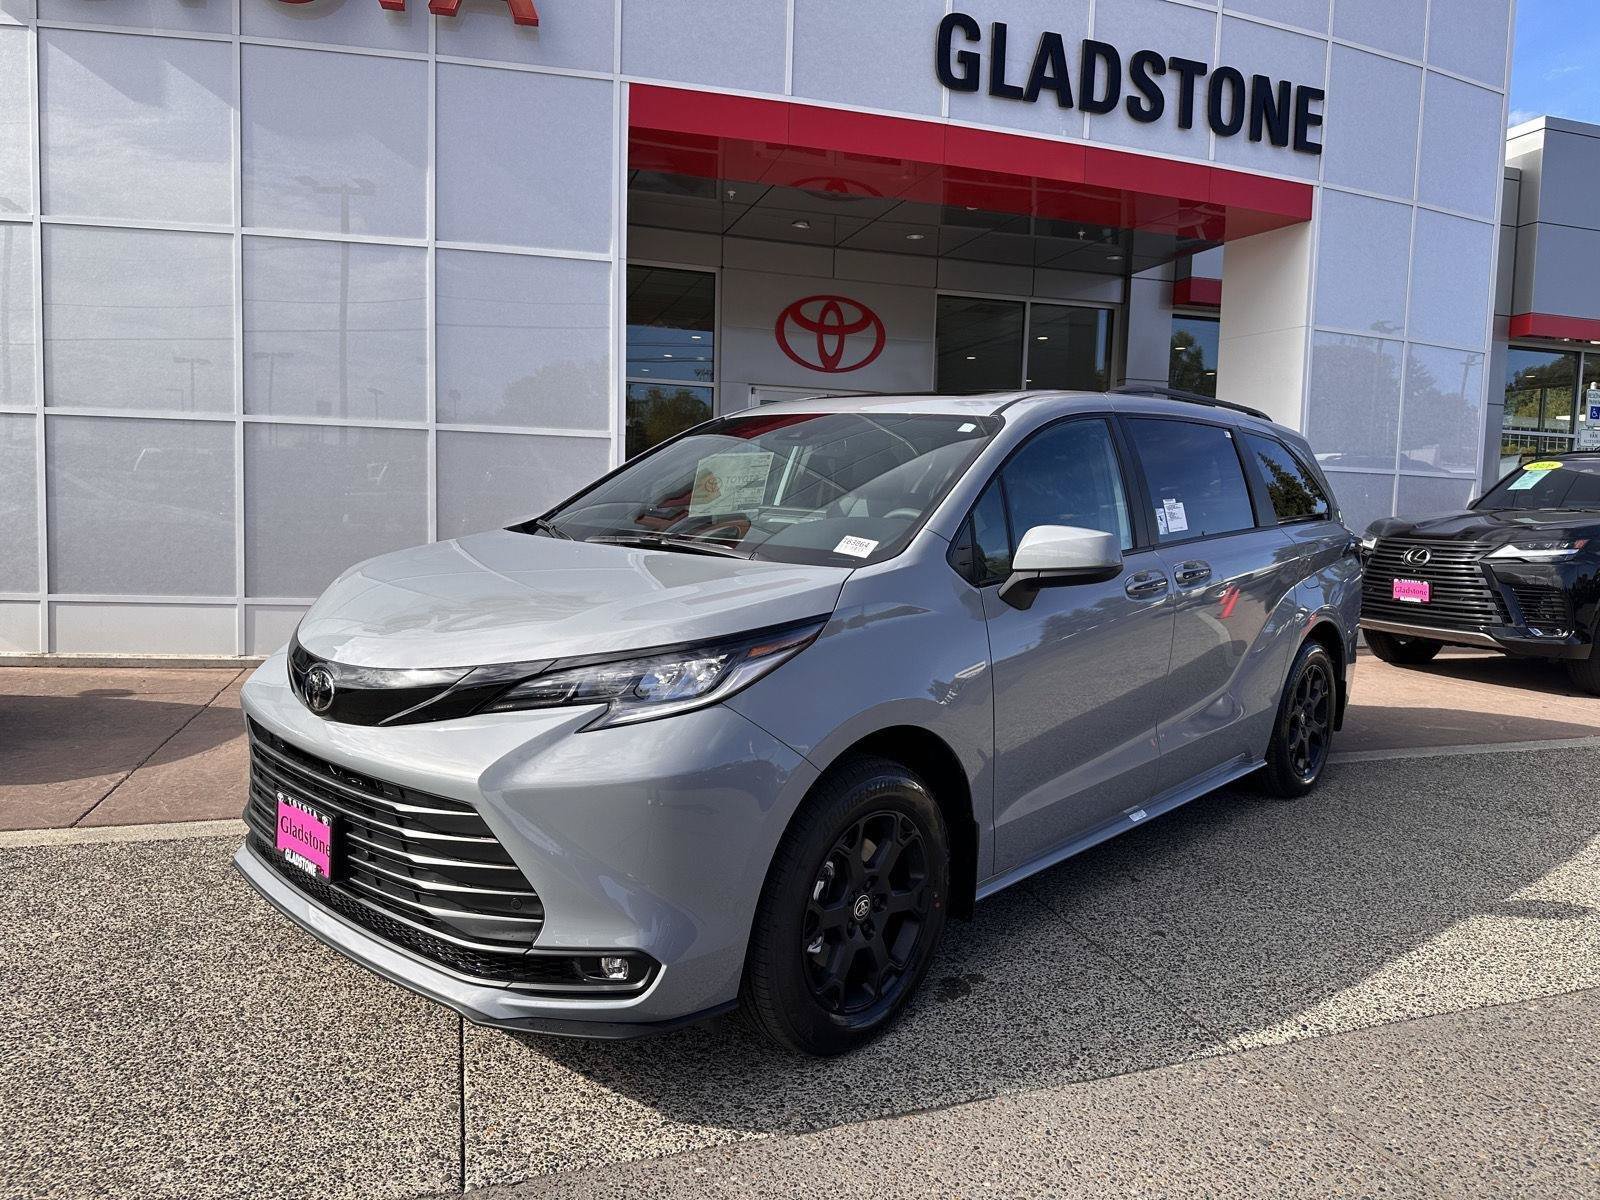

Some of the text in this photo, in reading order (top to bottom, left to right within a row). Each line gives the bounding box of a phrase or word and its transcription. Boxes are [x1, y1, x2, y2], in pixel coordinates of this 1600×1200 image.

[935, 12, 1325, 155] GLADSTONE
[1395, 586, 1428, 596] Gladstone
[288, 796, 319, 819] TOYOTA
[281, 816, 330, 858] Gladstone
[285, 848, 317, 877] GLADSTONE
